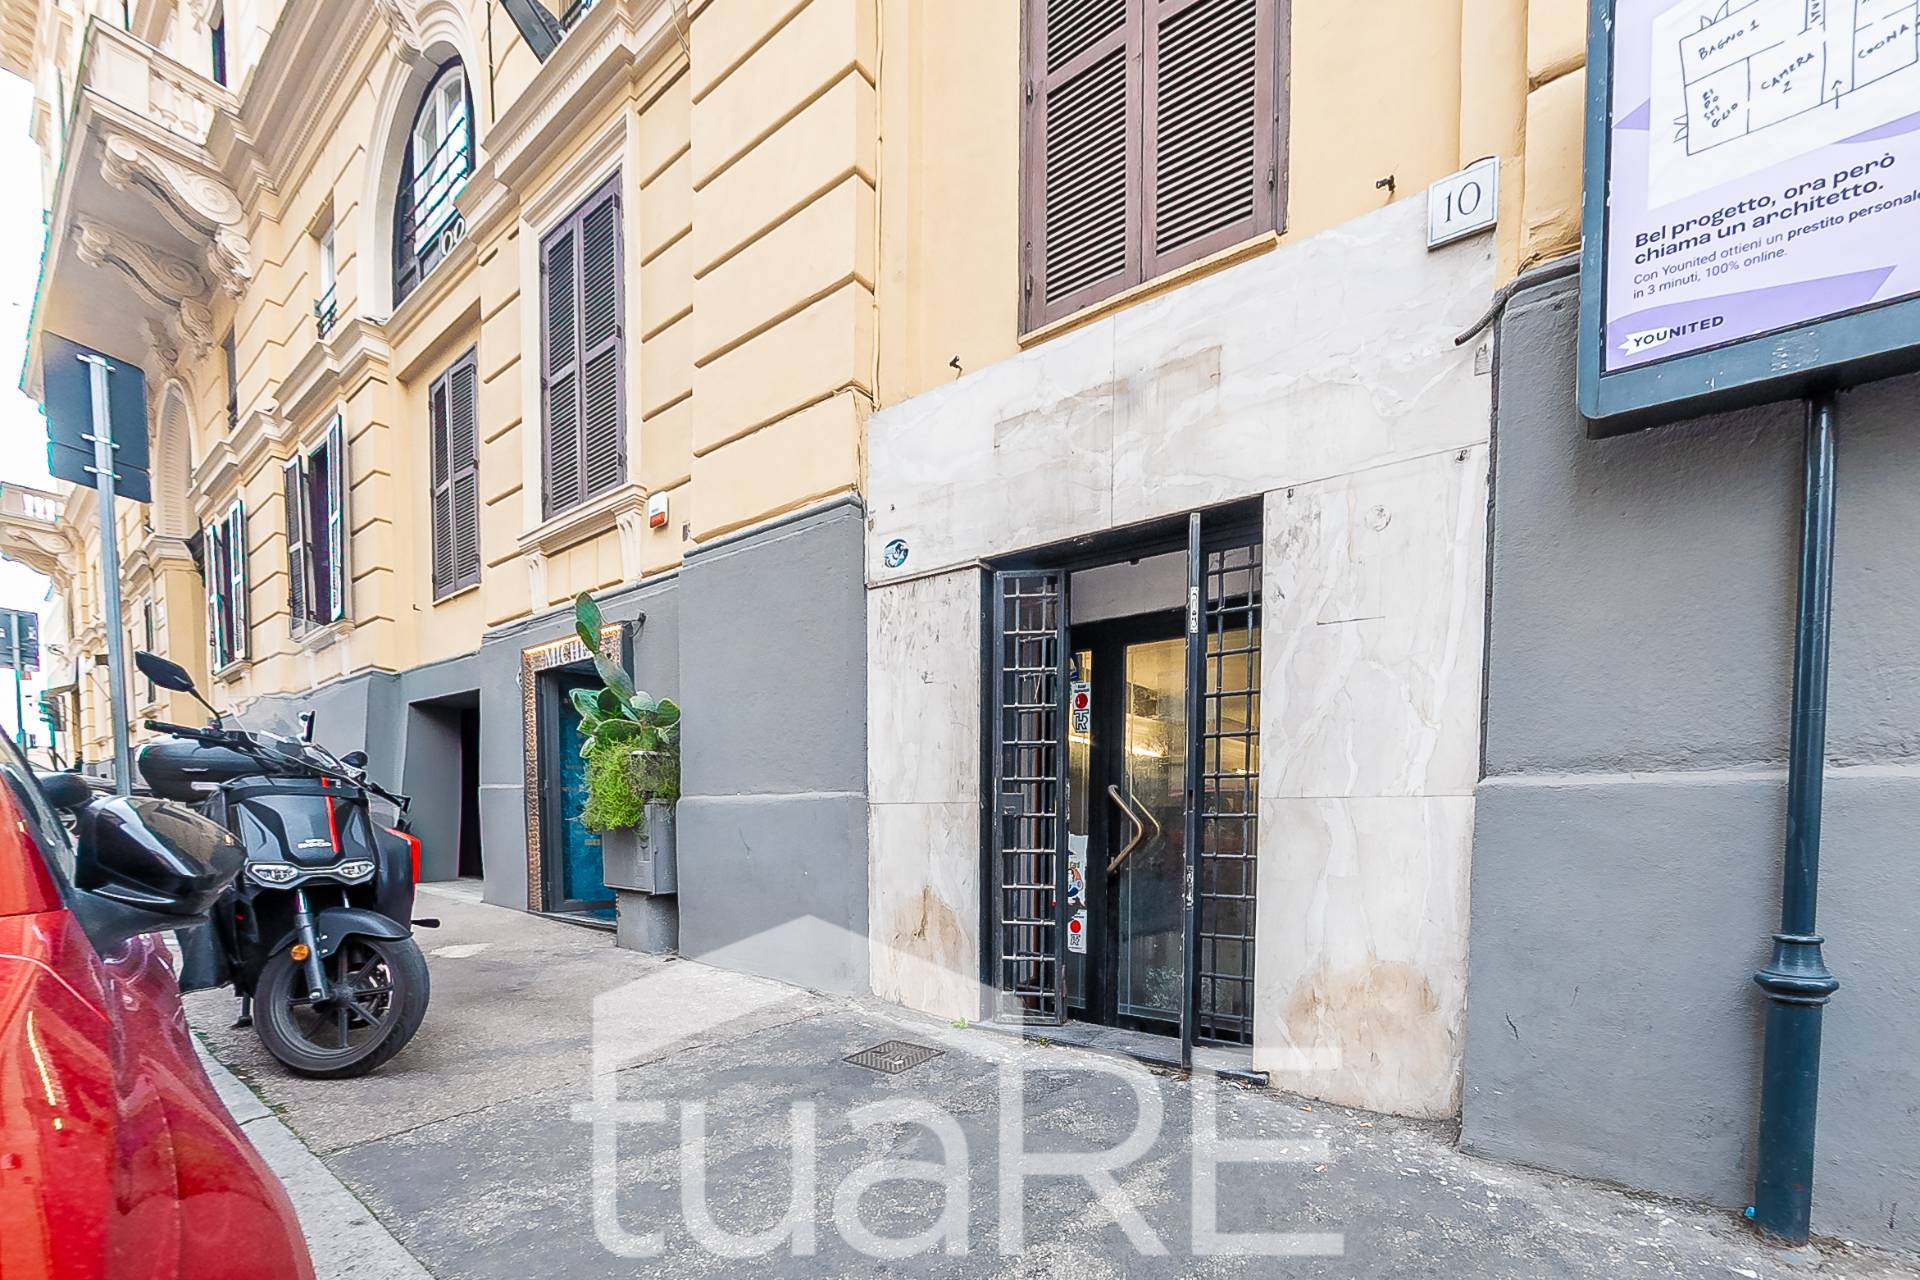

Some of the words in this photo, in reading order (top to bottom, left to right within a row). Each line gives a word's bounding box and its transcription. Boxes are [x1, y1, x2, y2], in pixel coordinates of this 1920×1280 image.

[1698, 29, 1744, 60] BAGNO
[1760, 52, 1815, 90] CAMERA
[1444, 181, 1481, 223] 10
[1635, 225, 1666, 248] Bel
[1671, 195, 1776, 240] progetto,
[1784, 177, 1826, 200] ora
[1833, 152, 1895, 188] però
[1635, 232, 1711, 265] chiama
[1717, 221, 1746, 239] un
[1752, 180, 1884, 229] architetto.
[1633, 270, 1658, 285] Con
[1662, 251, 1717, 277] Younited
[1720, 236, 1762, 259] ottieni
[1766, 232, 1783, 246] un
[1787, 215, 1845, 241] prestito
[1633, 288, 1644, 299] in
[1647, 284, 1656, 295] 3
[1659, 272, 1701, 292] minuti,
[1706, 259, 1740, 278] 100%
[1633, 315, 1724, 348] YOUNITED
